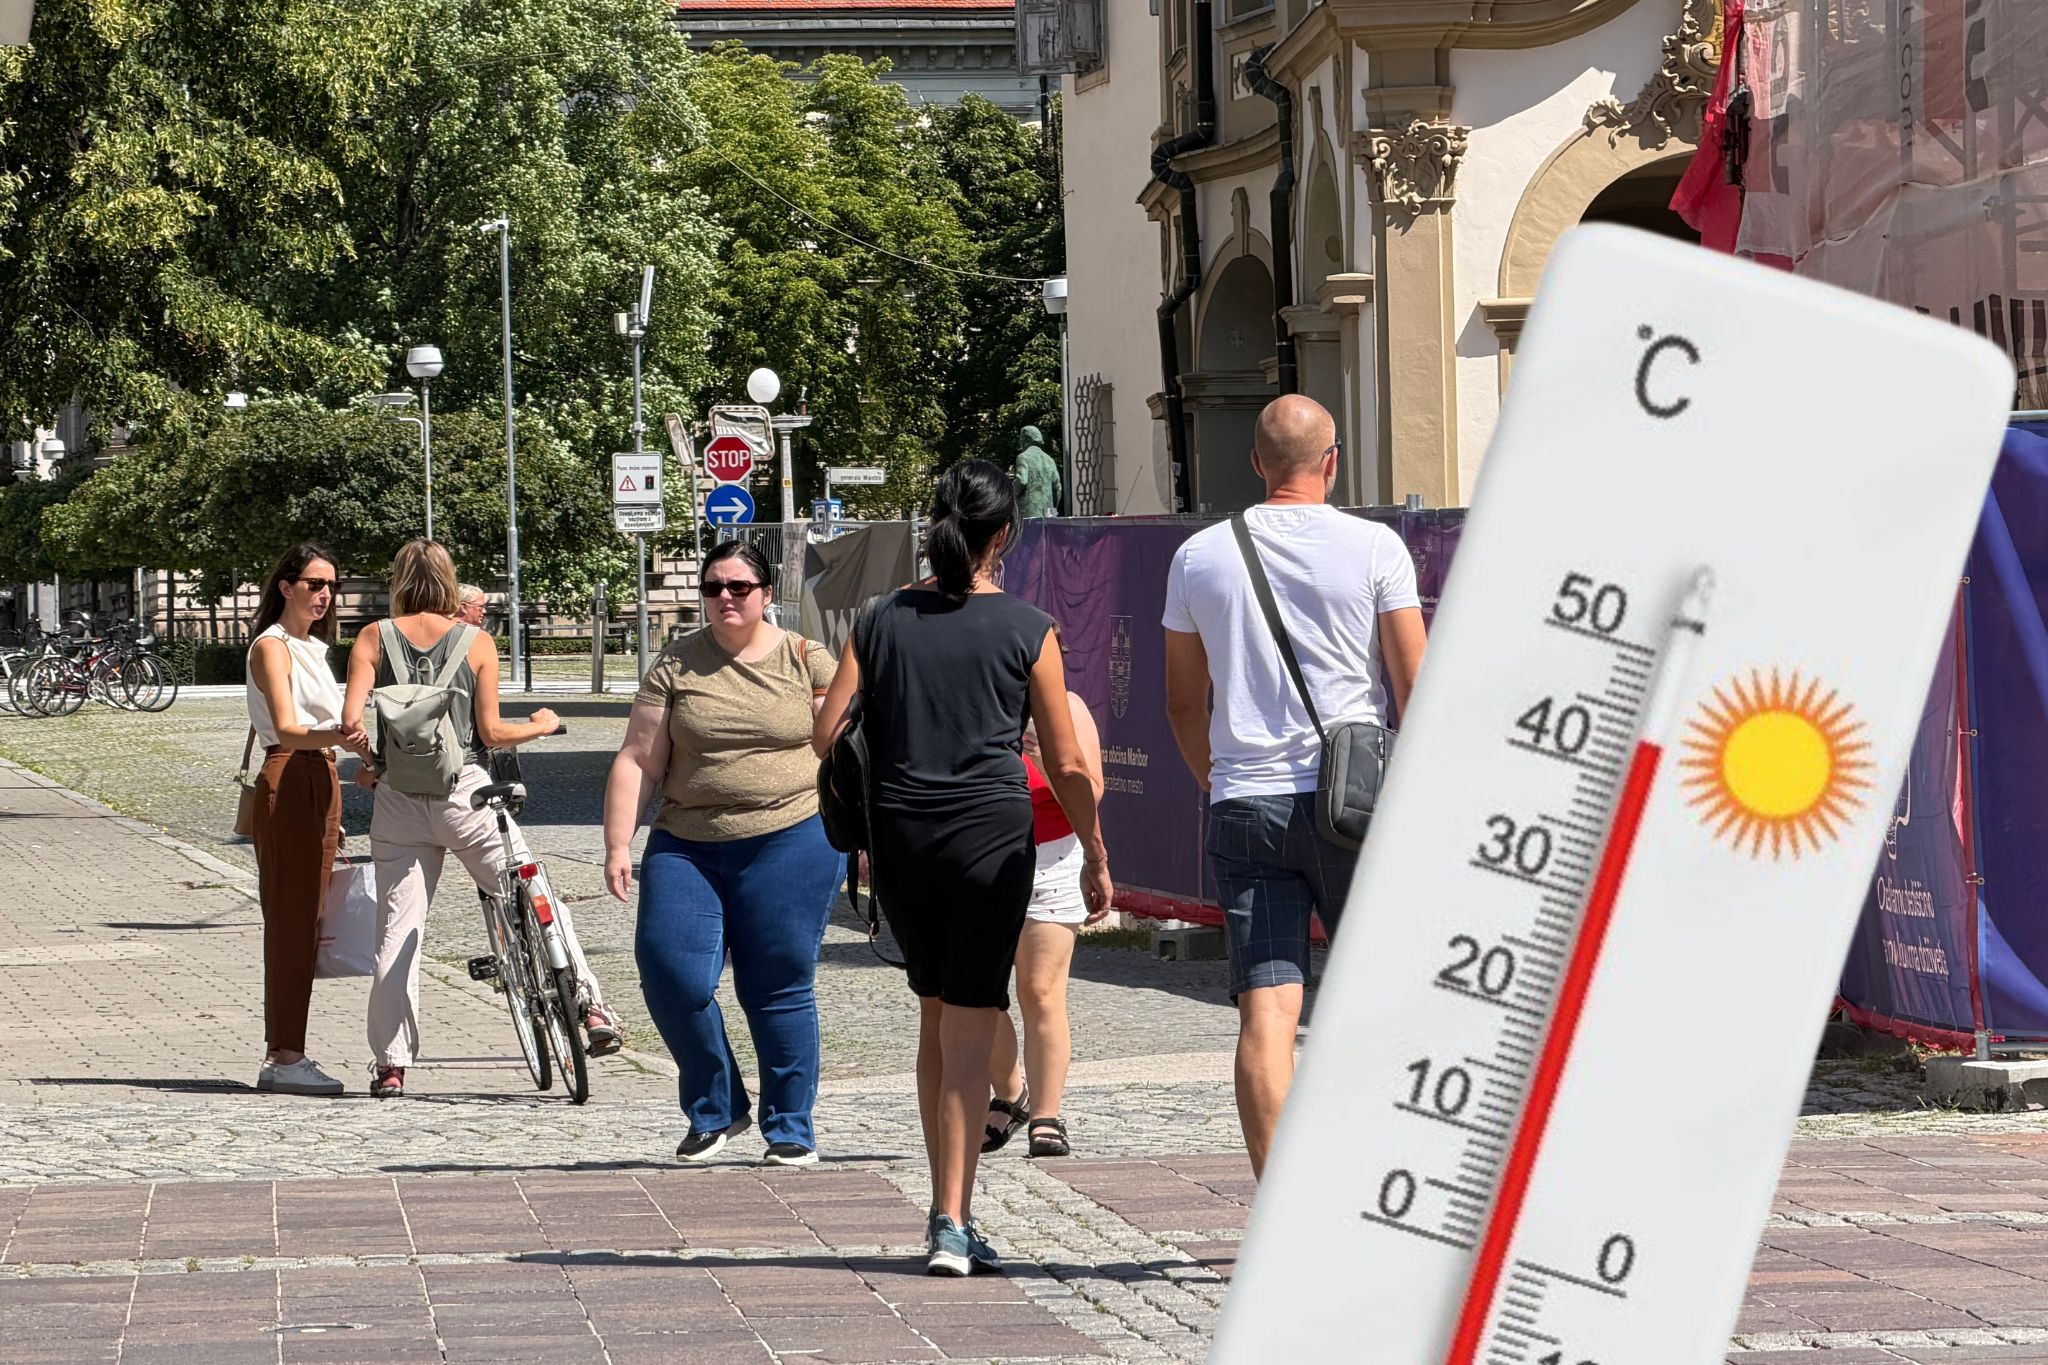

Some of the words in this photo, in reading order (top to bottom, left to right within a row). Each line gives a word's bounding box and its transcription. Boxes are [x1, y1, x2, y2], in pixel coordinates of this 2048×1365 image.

[708, 449, 750, 468] STOP
[1553, 571, 1627, 633] 50
[1516, 696, 1589, 754] 40
[1479, 813, 1552, 876] 30
[1439, 933, 1515, 996] 20
[1406, 1057, 1471, 1117] 10
[1379, 1169, 1416, 1219] 0
[1598, 1233, 1634, 1284] 0
